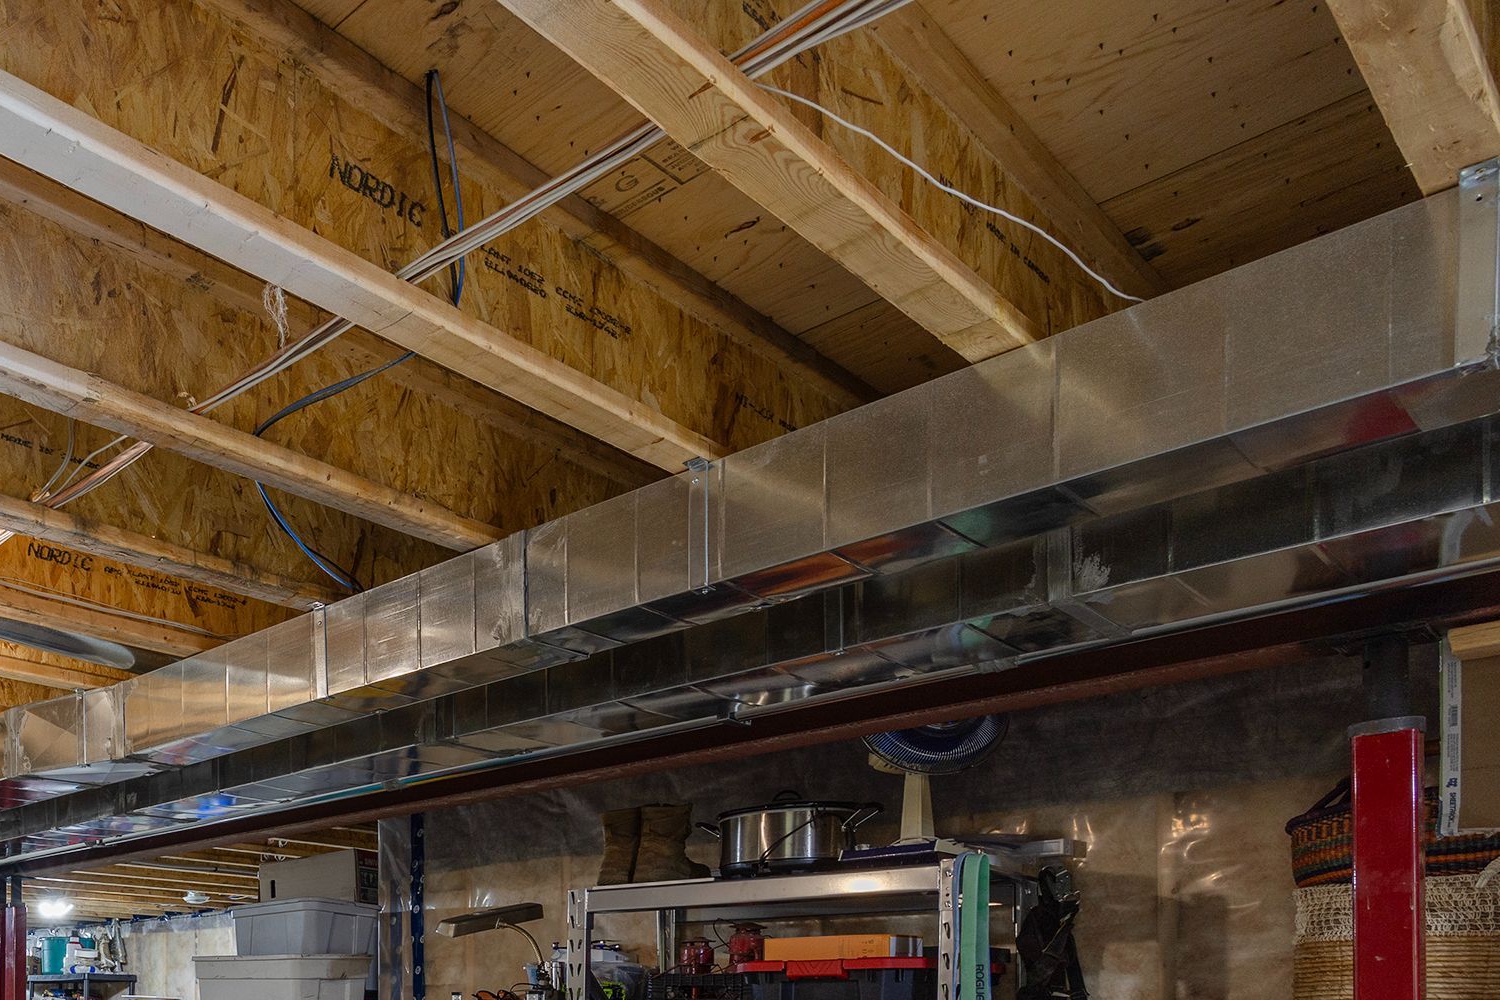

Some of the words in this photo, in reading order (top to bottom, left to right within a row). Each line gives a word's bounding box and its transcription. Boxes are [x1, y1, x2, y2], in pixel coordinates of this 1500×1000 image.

[329, 153, 426, 227] NORDIC
[479, 244, 512, 265] LANT
[27, 542, 94, 572] NORDIC
[975, 963, 985, 1000] ROGUE
